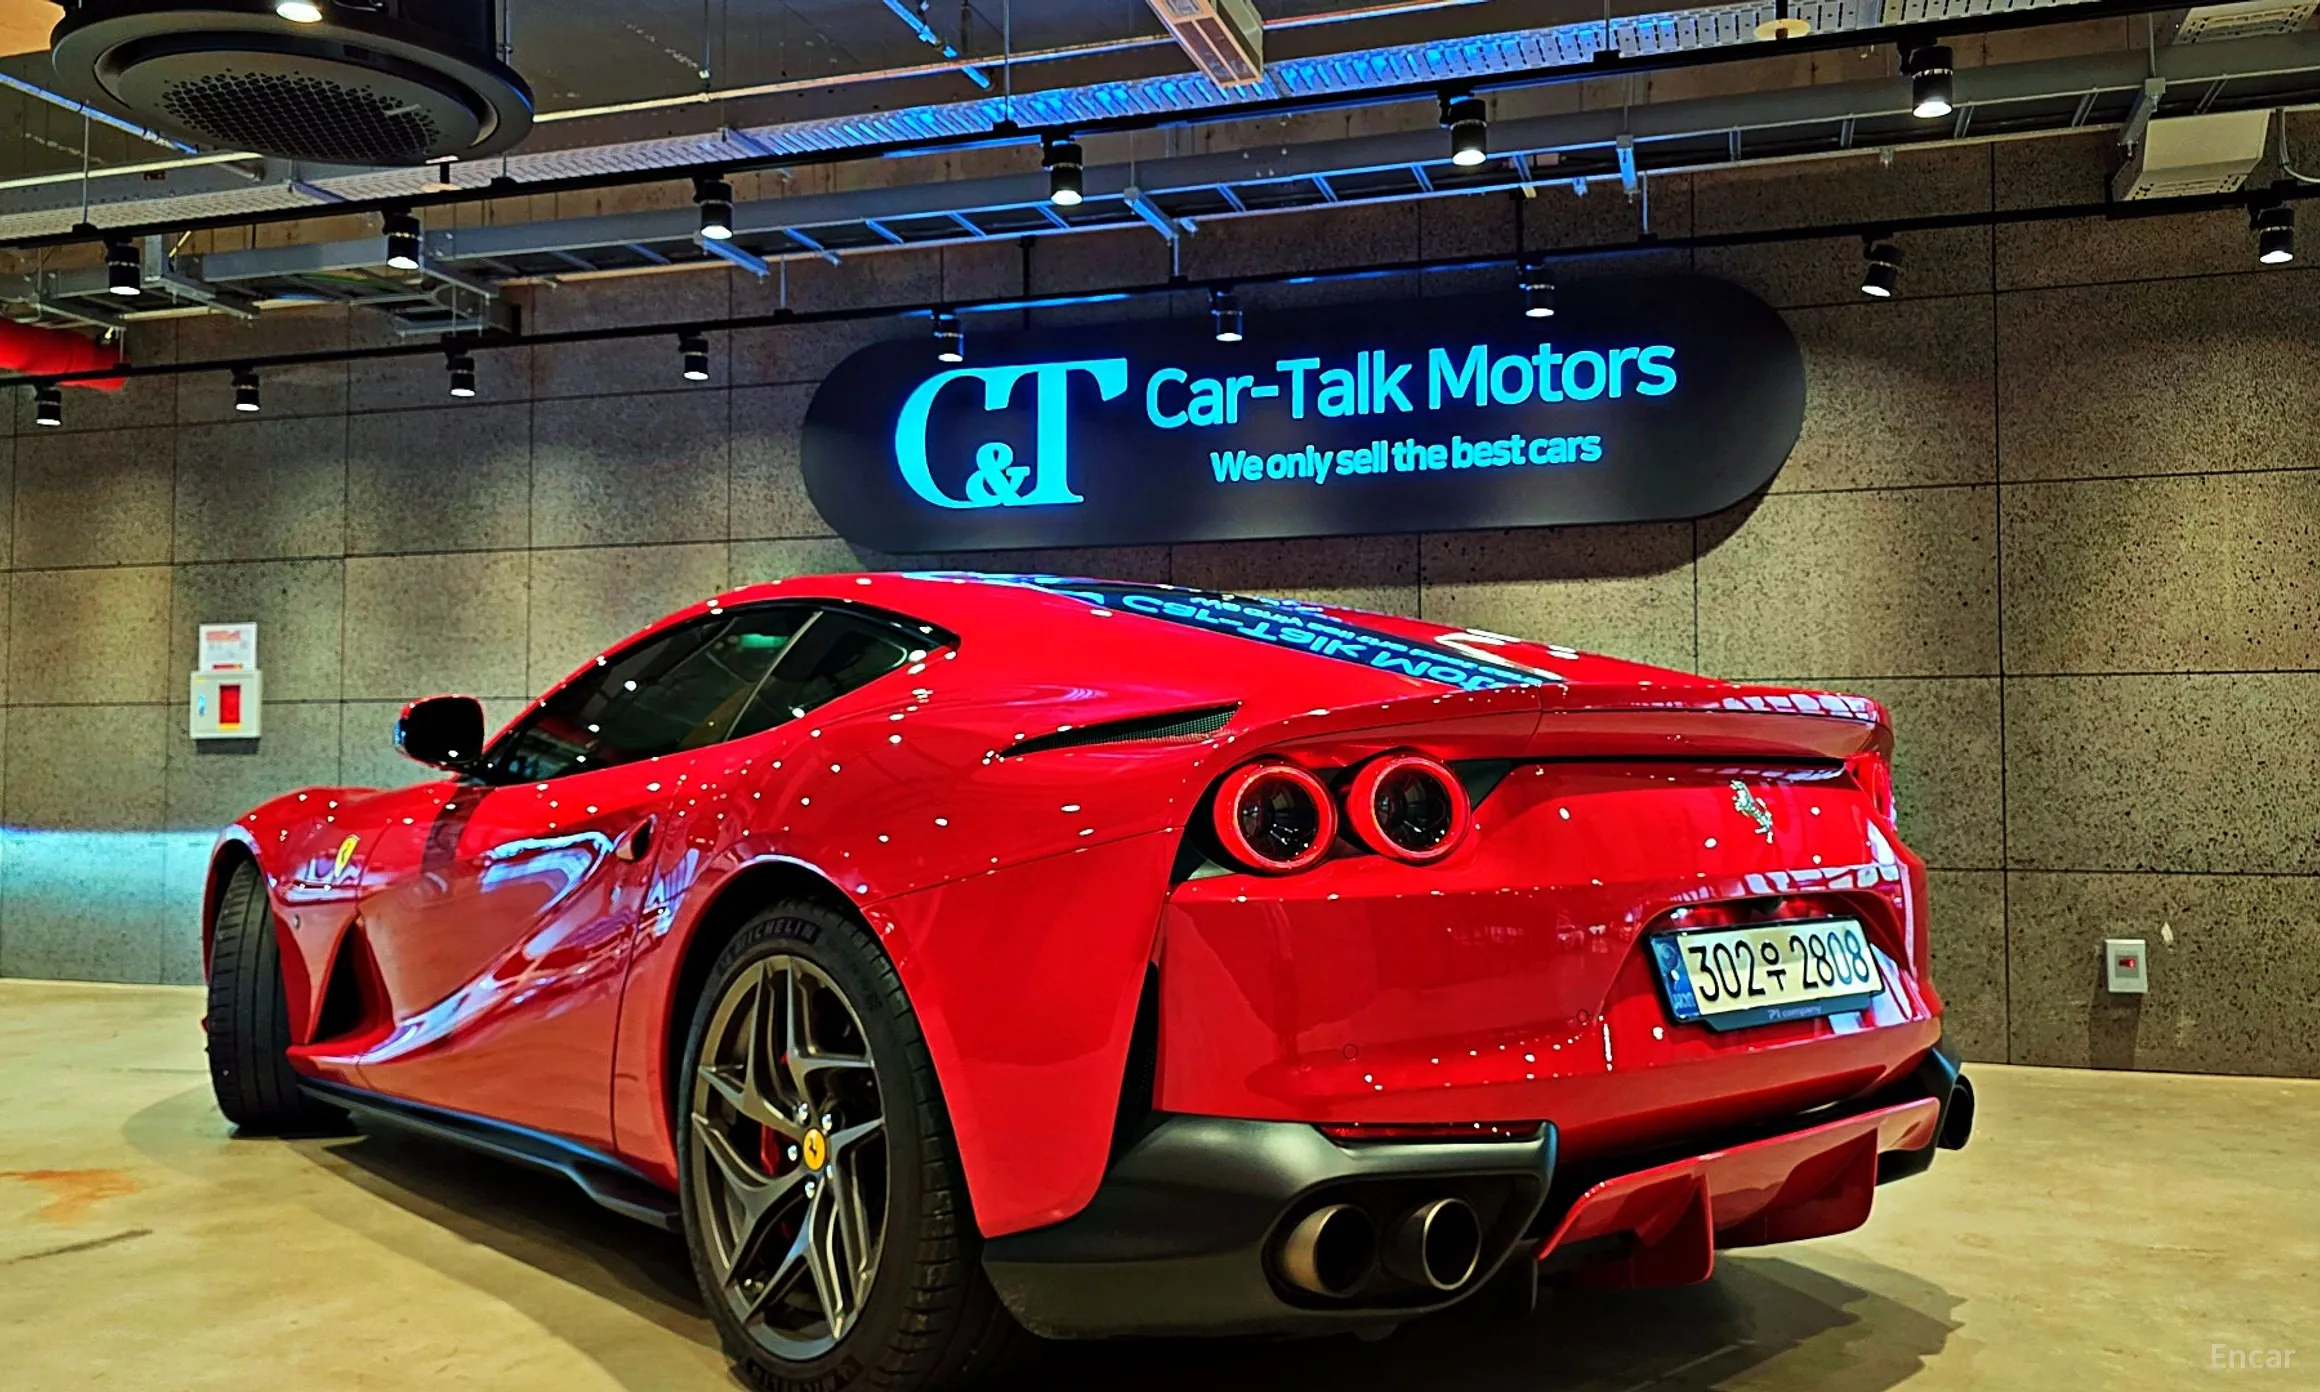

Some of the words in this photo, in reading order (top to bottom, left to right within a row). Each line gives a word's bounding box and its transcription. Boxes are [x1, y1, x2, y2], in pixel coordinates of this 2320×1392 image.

[1146, 349, 1414, 429] Car-Talk
[1428, 342, 1677, 410] Motors
[1210, 449, 1264, 483] We
[1266, 444, 1334, 485] only
[1335, 439, 1389, 476] sell
[1391, 438, 1449, 472] the
[1451, 434, 1527, 469] best
[1528, 435, 1603, 465] cars
